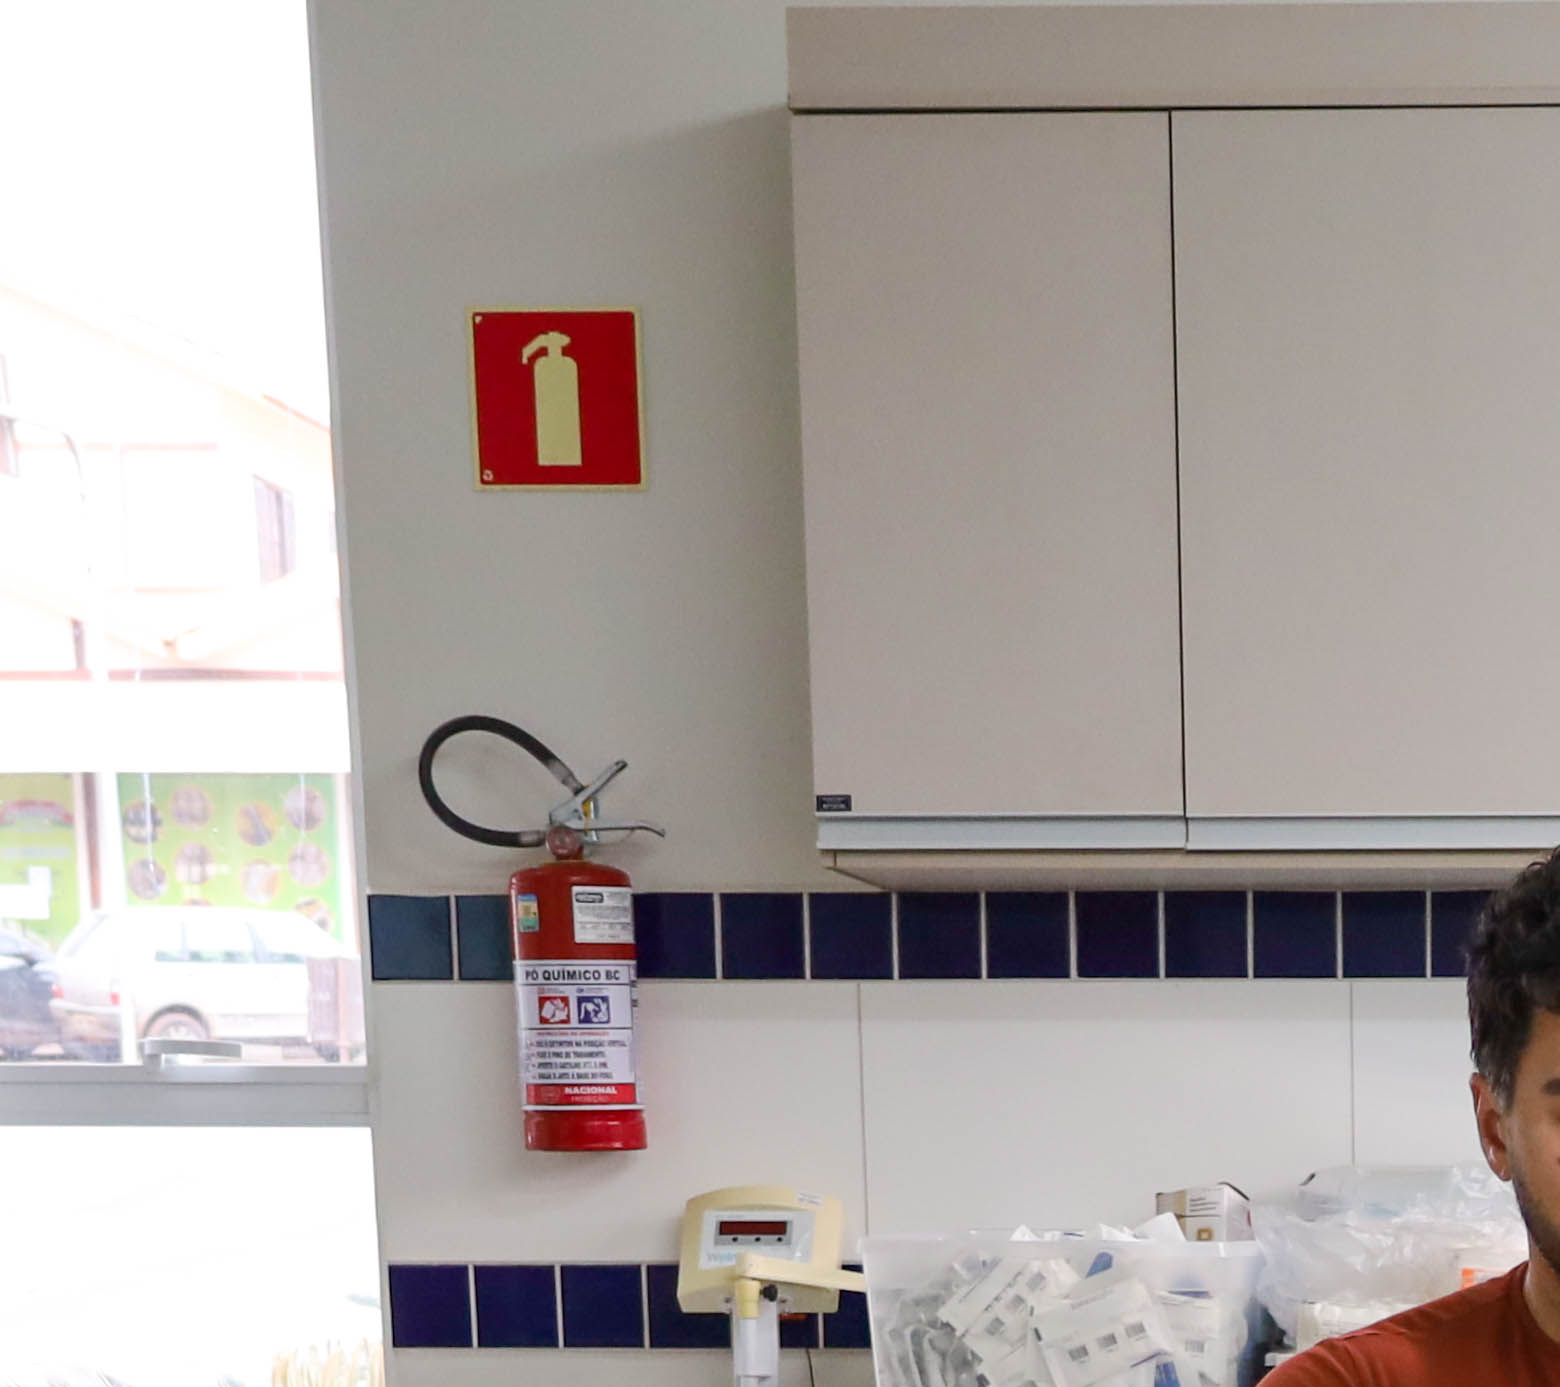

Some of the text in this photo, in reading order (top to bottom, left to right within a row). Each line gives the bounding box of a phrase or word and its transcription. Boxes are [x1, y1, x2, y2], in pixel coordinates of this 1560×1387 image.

[524, 968, 621, 981] PÓ QUÍMICO BC
[564, 1085, 618, 1095] NACIONAL
